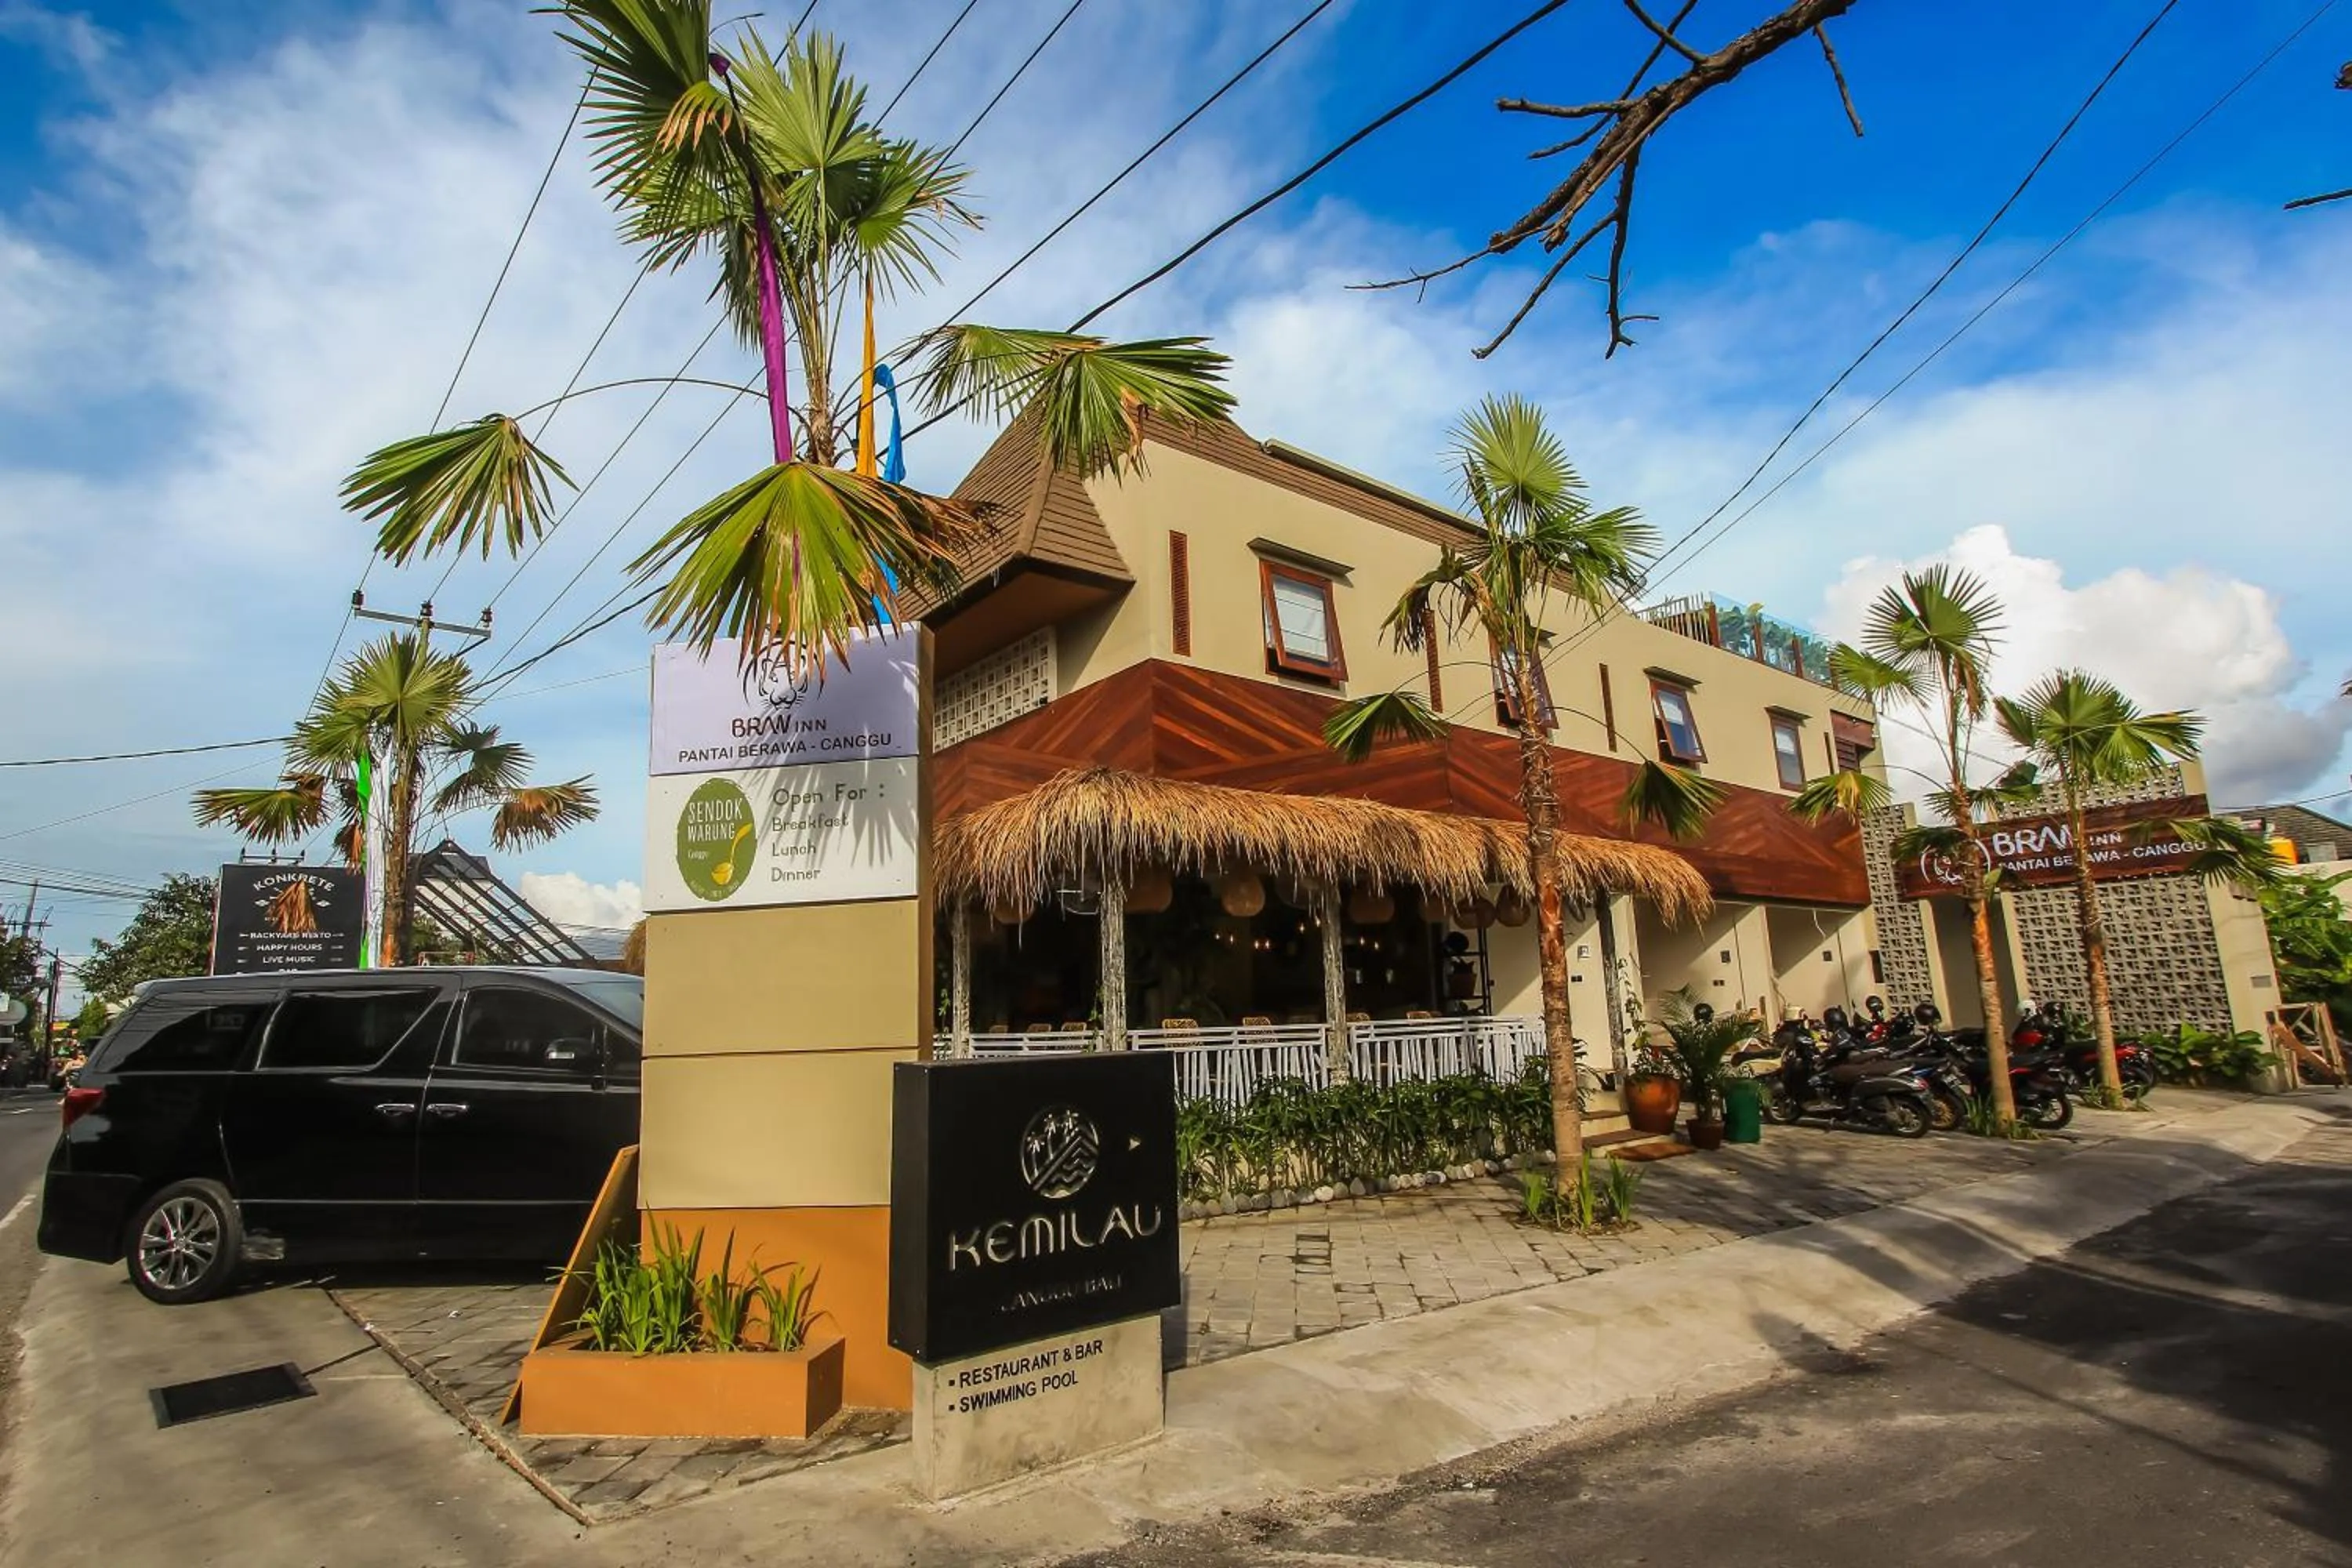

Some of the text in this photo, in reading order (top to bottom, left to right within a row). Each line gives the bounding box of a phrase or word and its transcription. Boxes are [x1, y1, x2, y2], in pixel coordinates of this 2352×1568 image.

[796, 718, 826, 732] INN
[678, 746, 733, 763] PANTAI
[738, 741, 807, 758] BERAWA
[822, 733, 891, 751] CANGGU
[773, 788, 823, 811] Open
[835, 783, 867, 802] For
[688, 797, 743, 823] SENDOK
[771, 812, 849, 832] Breakfast
[688, 822, 735, 842] WARUNG
[2089, 831, 2122, 846] INN
[771, 840, 817, 858] Lunch
[2053, 848, 2121, 866] BEAWA
[2132, 841, 2206, 858] CANGGU
[771, 866, 822, 883] Dinner
[948, 1203, 1162, 1272] KEMILAU
[960, 1339, 1104, 1388] RESTAURANT & BAR
[959, 1370, 1080, 1413] SWIMMING POOL
